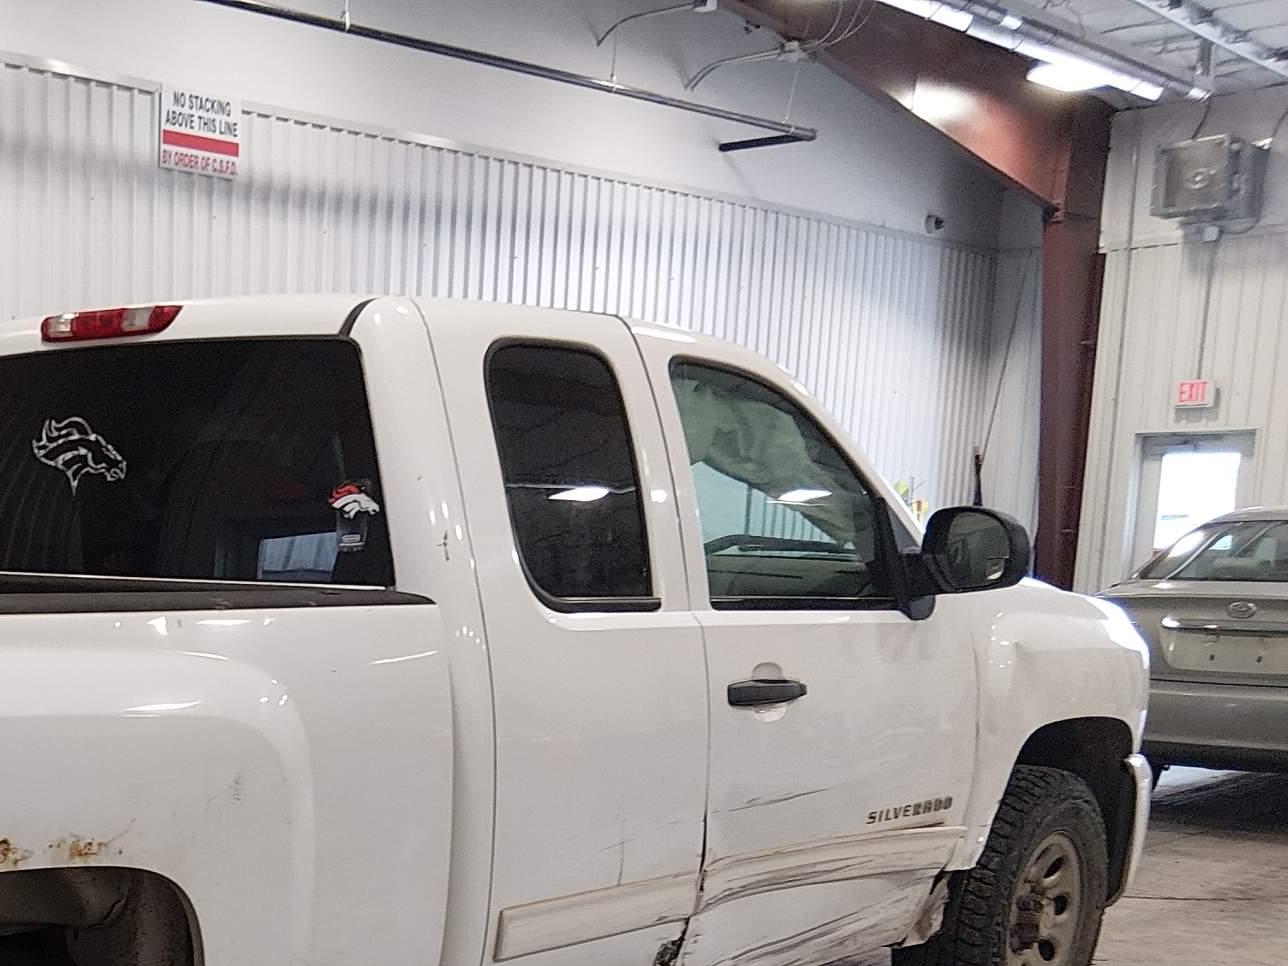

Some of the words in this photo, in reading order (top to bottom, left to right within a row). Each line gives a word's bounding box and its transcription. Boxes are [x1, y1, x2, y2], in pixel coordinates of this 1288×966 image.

[173, 90, 186, 108] NO
[188, 94, 232, 117] STACKING
[165, 109, 194, 130] ABOVE
[197, 115, 217, 133] THIS
[219, 119, 238, 138] LINE
[162, 149, 172, 165] BY
[173, 151, 199, 169] ORDER
[200, 155, 211, 171] OF
[1178, 381, 1208, 403] EXIT
[865, 796, 953, 825] SILVERADO
